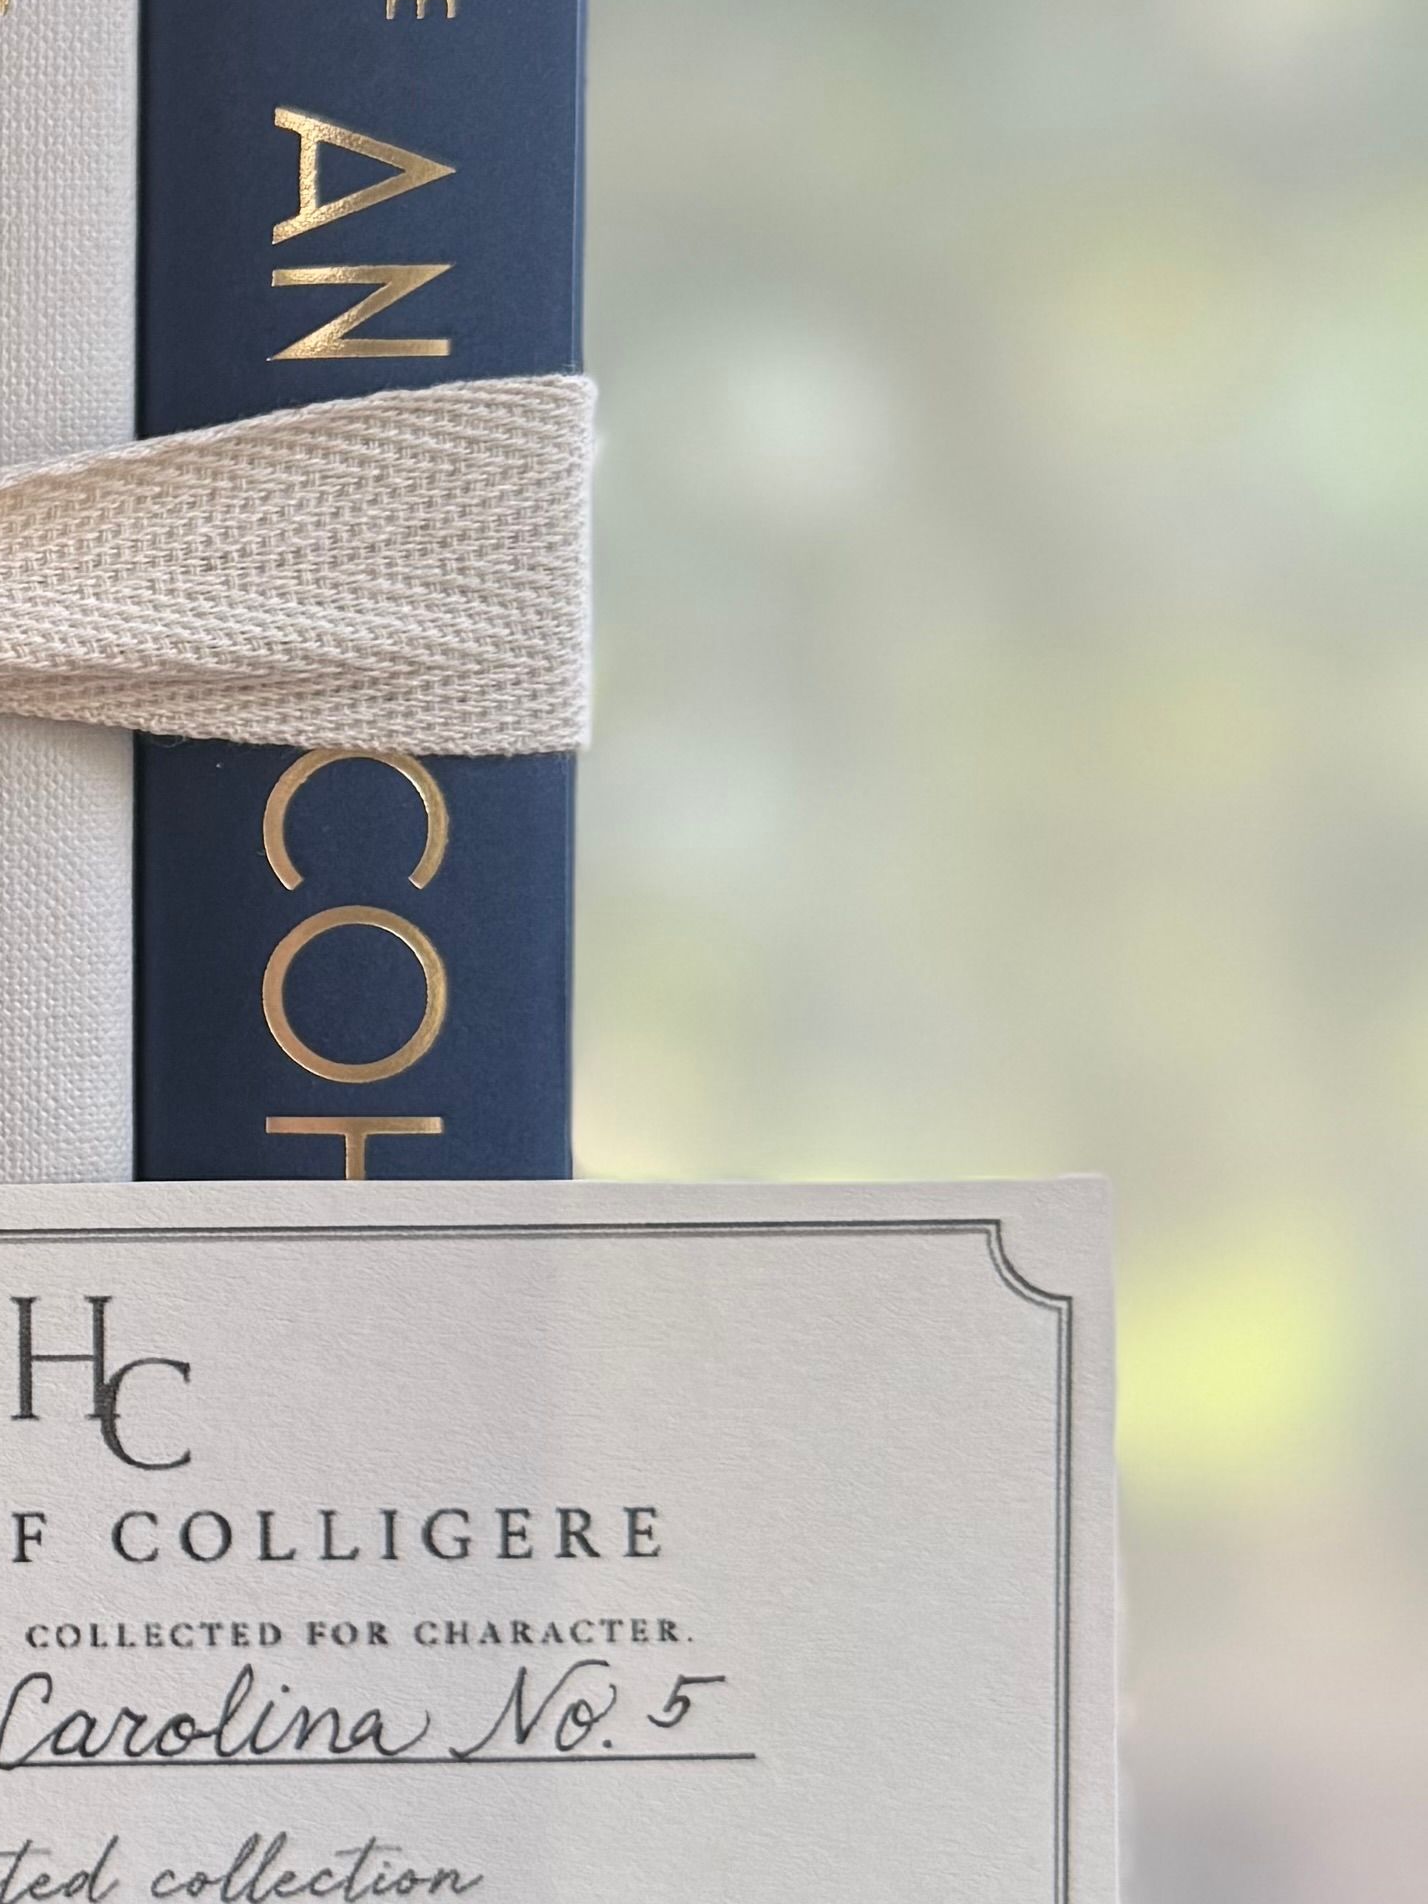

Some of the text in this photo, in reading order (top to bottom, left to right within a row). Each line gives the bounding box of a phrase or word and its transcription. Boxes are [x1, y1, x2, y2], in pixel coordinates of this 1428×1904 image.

[262, 748, 451, 1180] COH
[110, 1505, 663, 1565] COLLIGERE
[24, 1621, 284, 1651] COLLECTED
[305, 1620, 391, 1649] FOR
[413, 1617, 695, 1649] CHARACTER.
[449, 1658, 619, 1759] No.
[646, 1674, 727, 1729] 5
